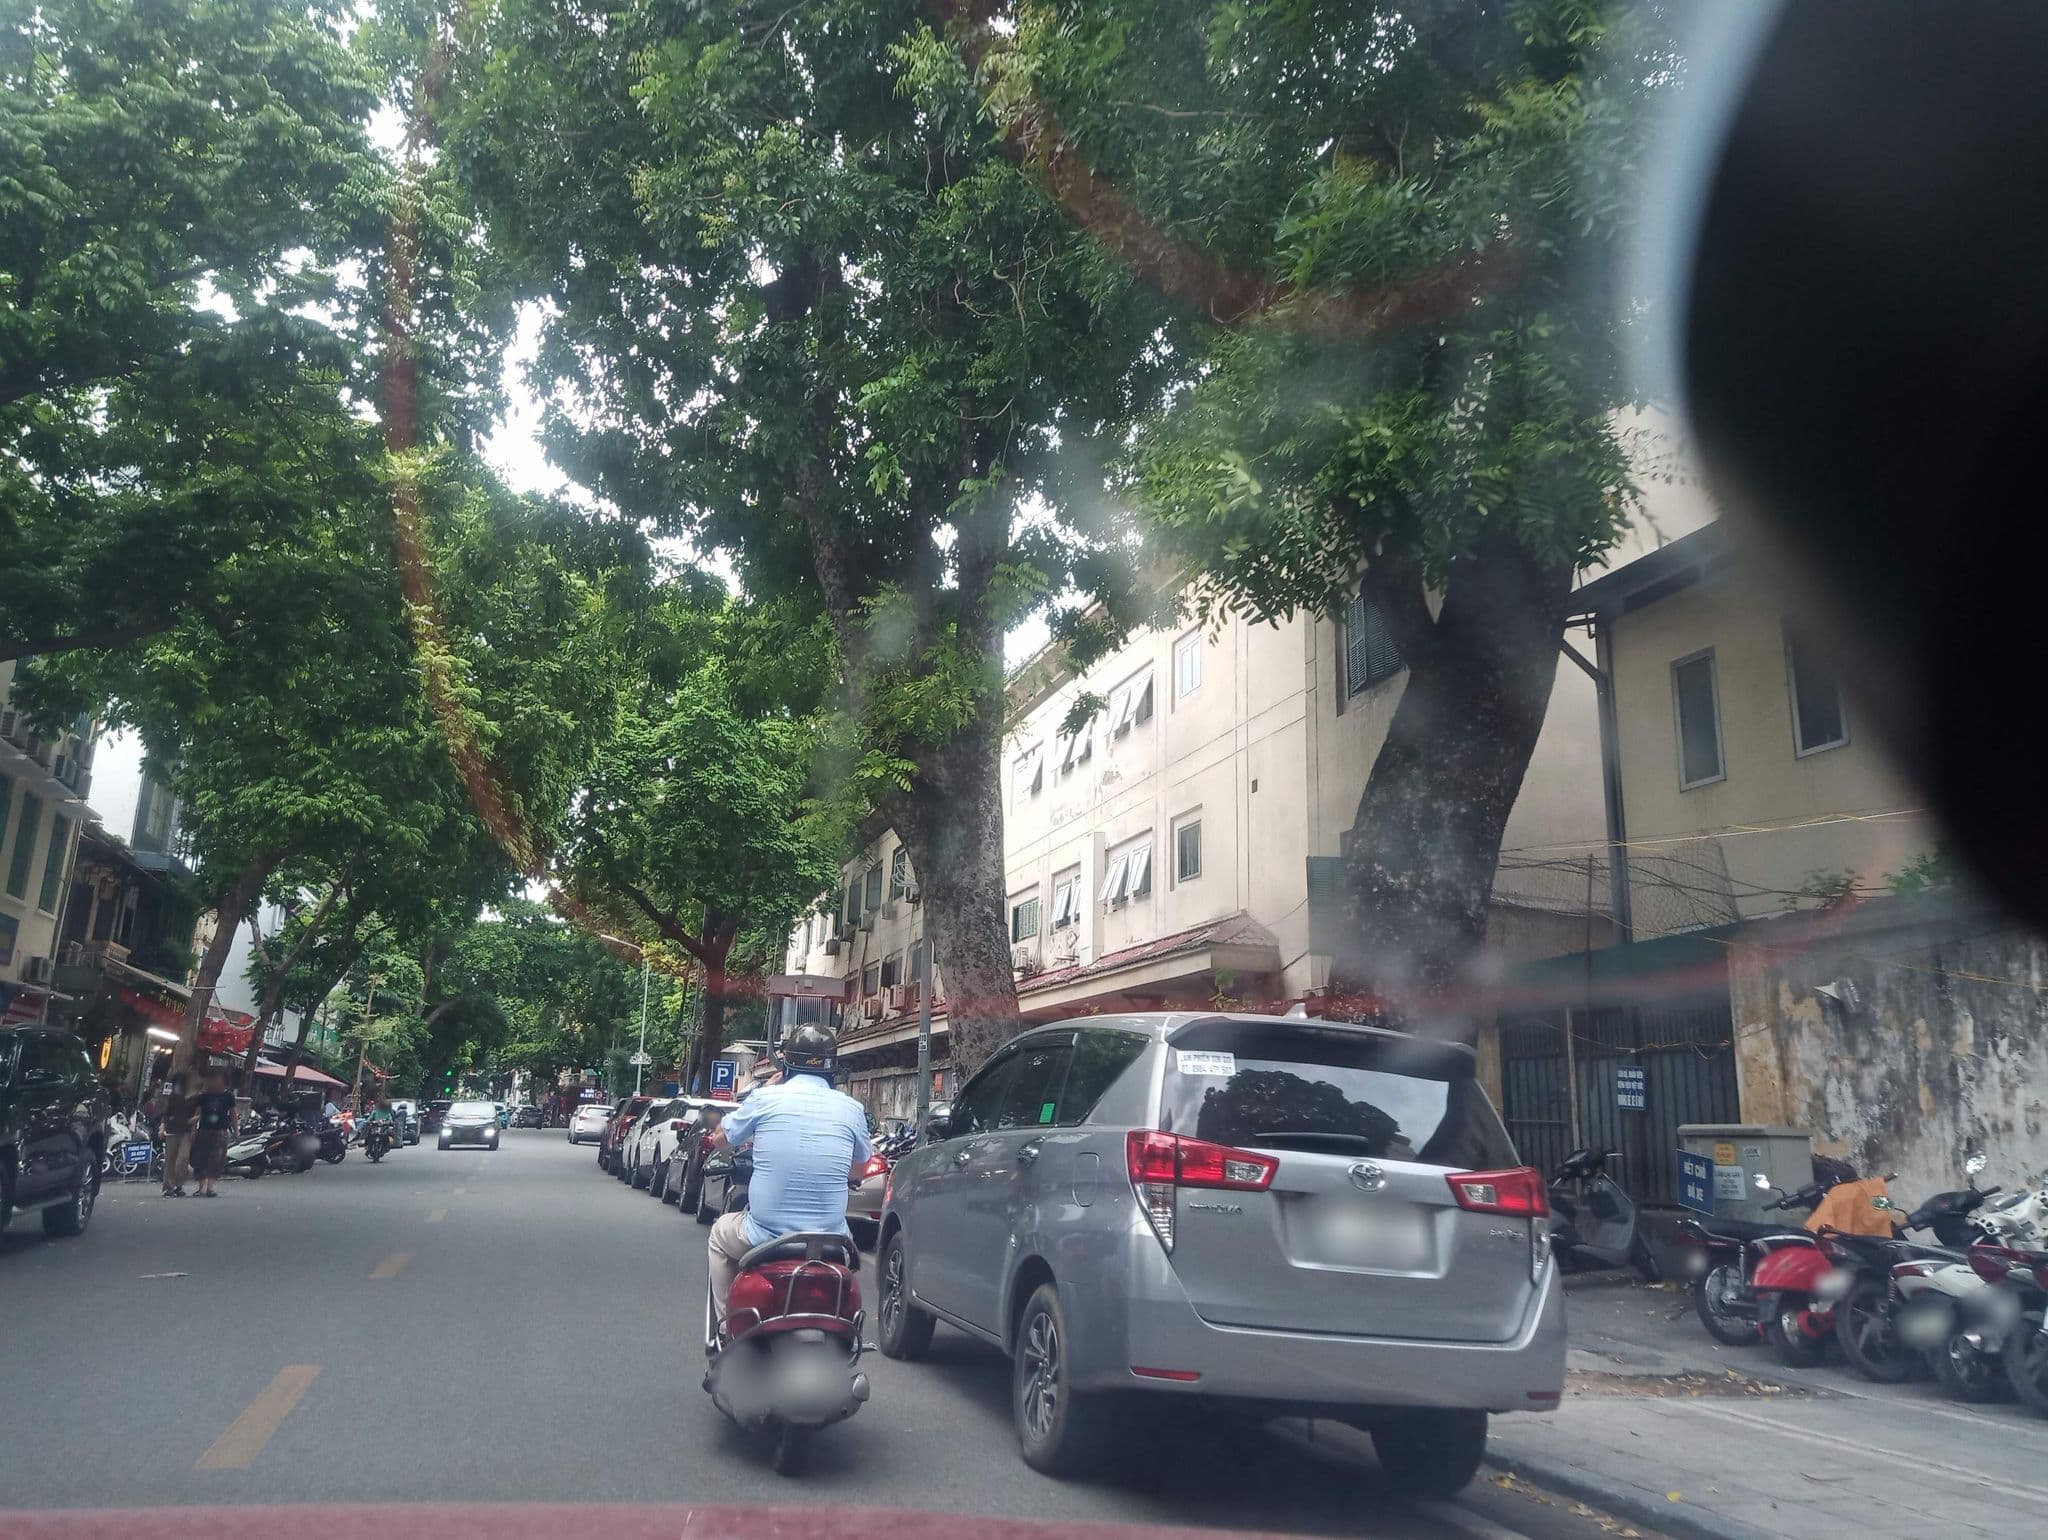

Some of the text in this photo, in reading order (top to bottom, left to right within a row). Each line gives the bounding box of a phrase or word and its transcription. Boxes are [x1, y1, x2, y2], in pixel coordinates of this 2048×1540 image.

[717, 1067, 729, 1082] P
[1683, 1158, 1694, 1175] HẾT
[1696, 1187, 1704, 1201] XE
